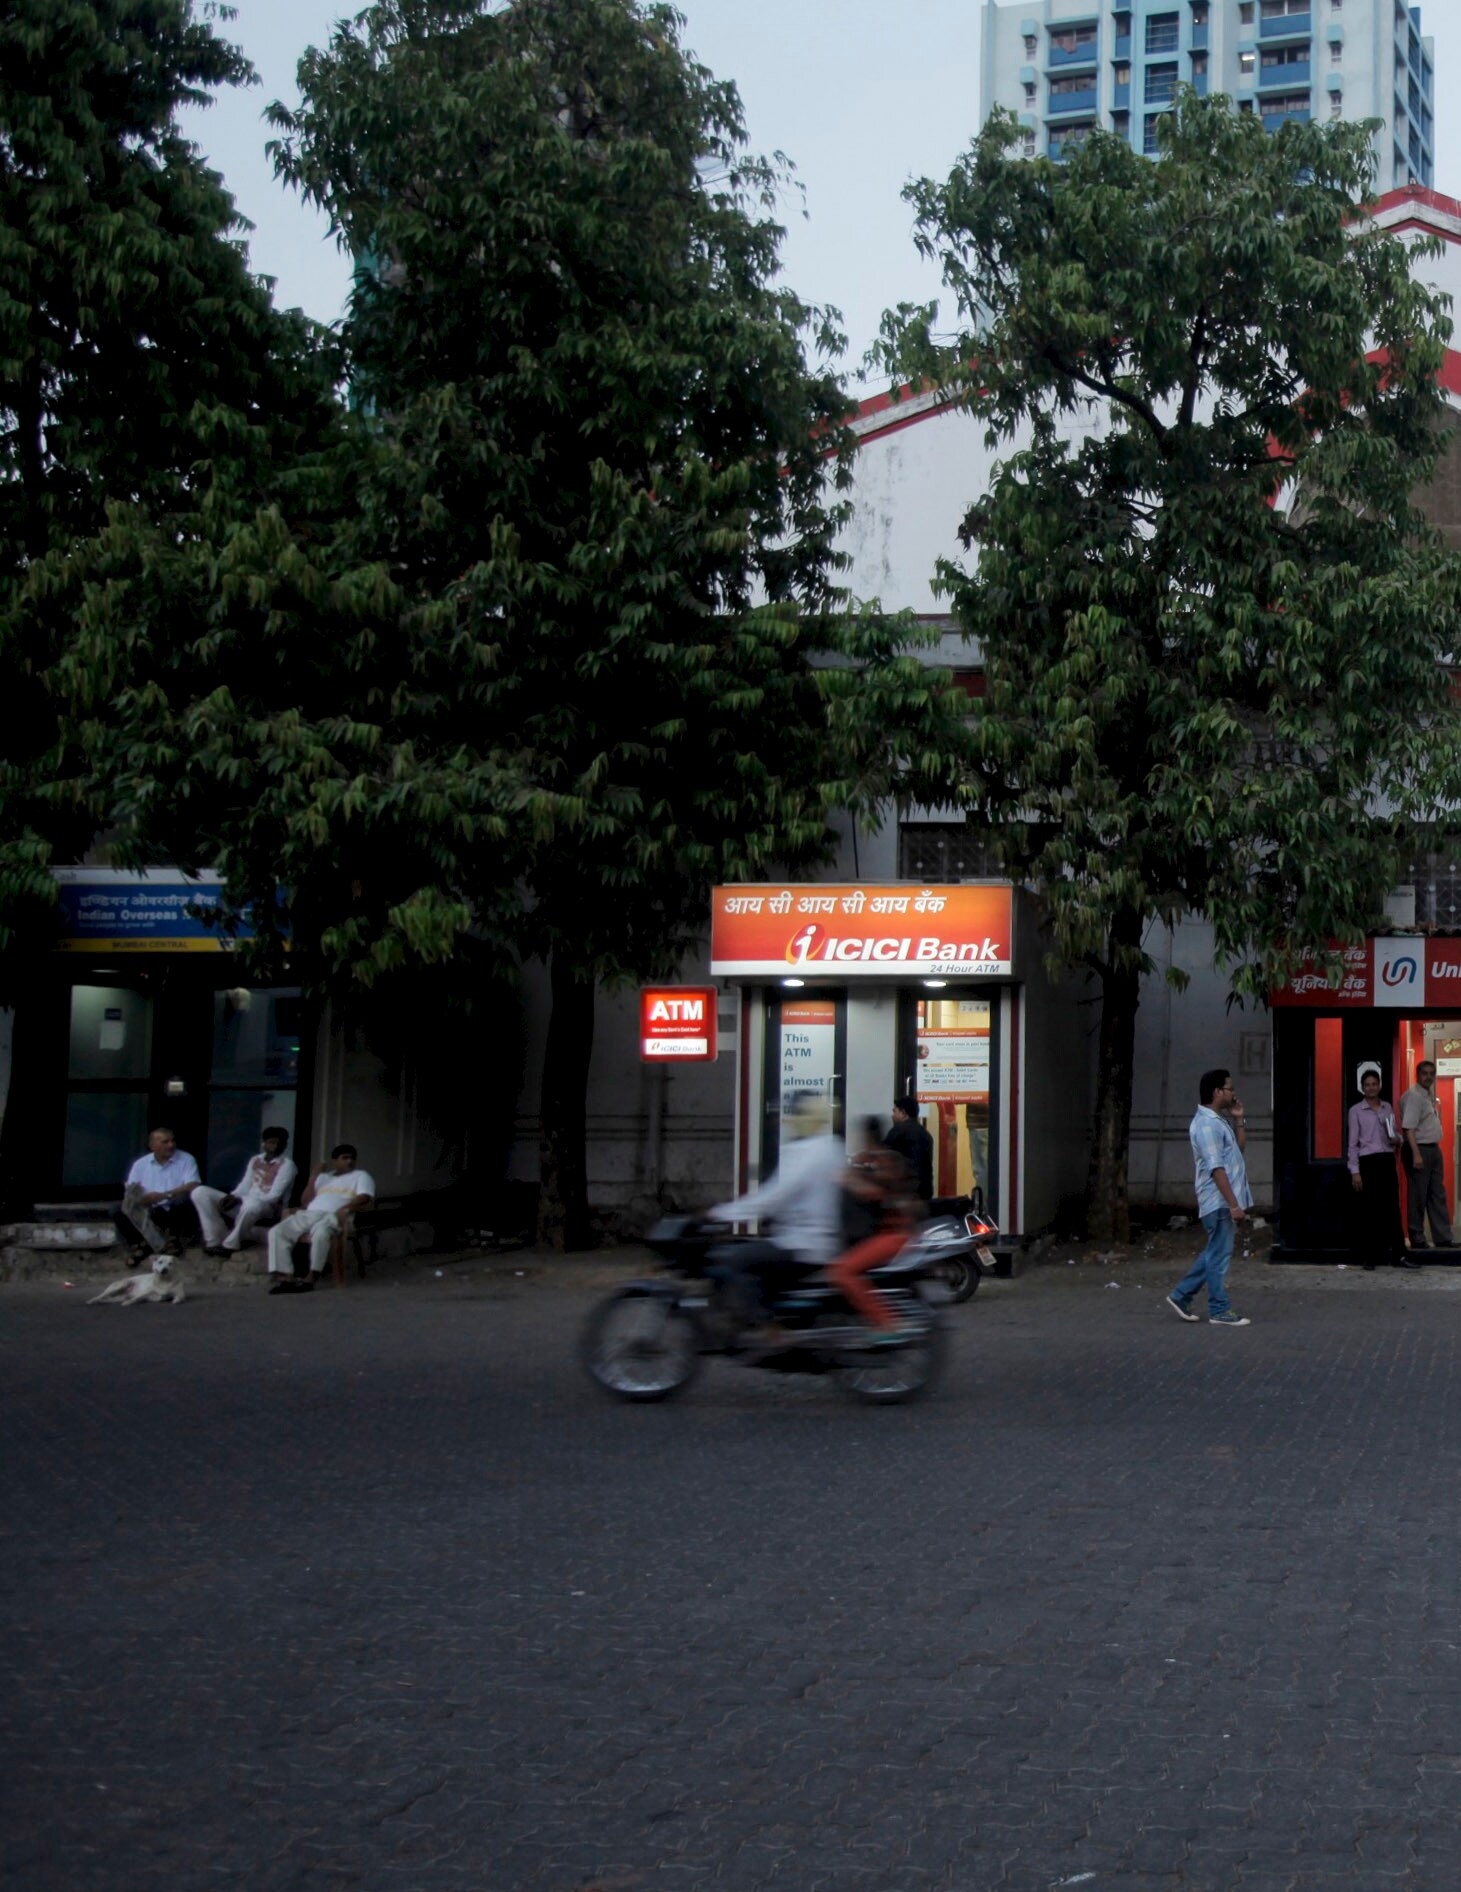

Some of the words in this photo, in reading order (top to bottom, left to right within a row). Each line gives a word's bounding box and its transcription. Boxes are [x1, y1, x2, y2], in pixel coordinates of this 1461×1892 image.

[724, 896, 764, 914] आय
[769, 891, 793, 914] सी
[797, 896, 837, 914] आय
[841, 891, 866, 914] सी
[870, 896, 910, 914] आय
[77, 909, 116, 920] Indian
[120, 909, 178, 921] Overseas
[824, 938, 911, 961] ICICI
[917, 938, 1000, 961] Bank
[930, 964, 943, 972] 24
[945, 964, 973, 972] Hour
[975, 964, 1000, 972] ATM
[650, 1000, 703, 1021] ATM
[784, 1034, 809, 1043] This
[784, 1048, 811, 1057] ATM
[783, 1077, 824, 1086] almost
